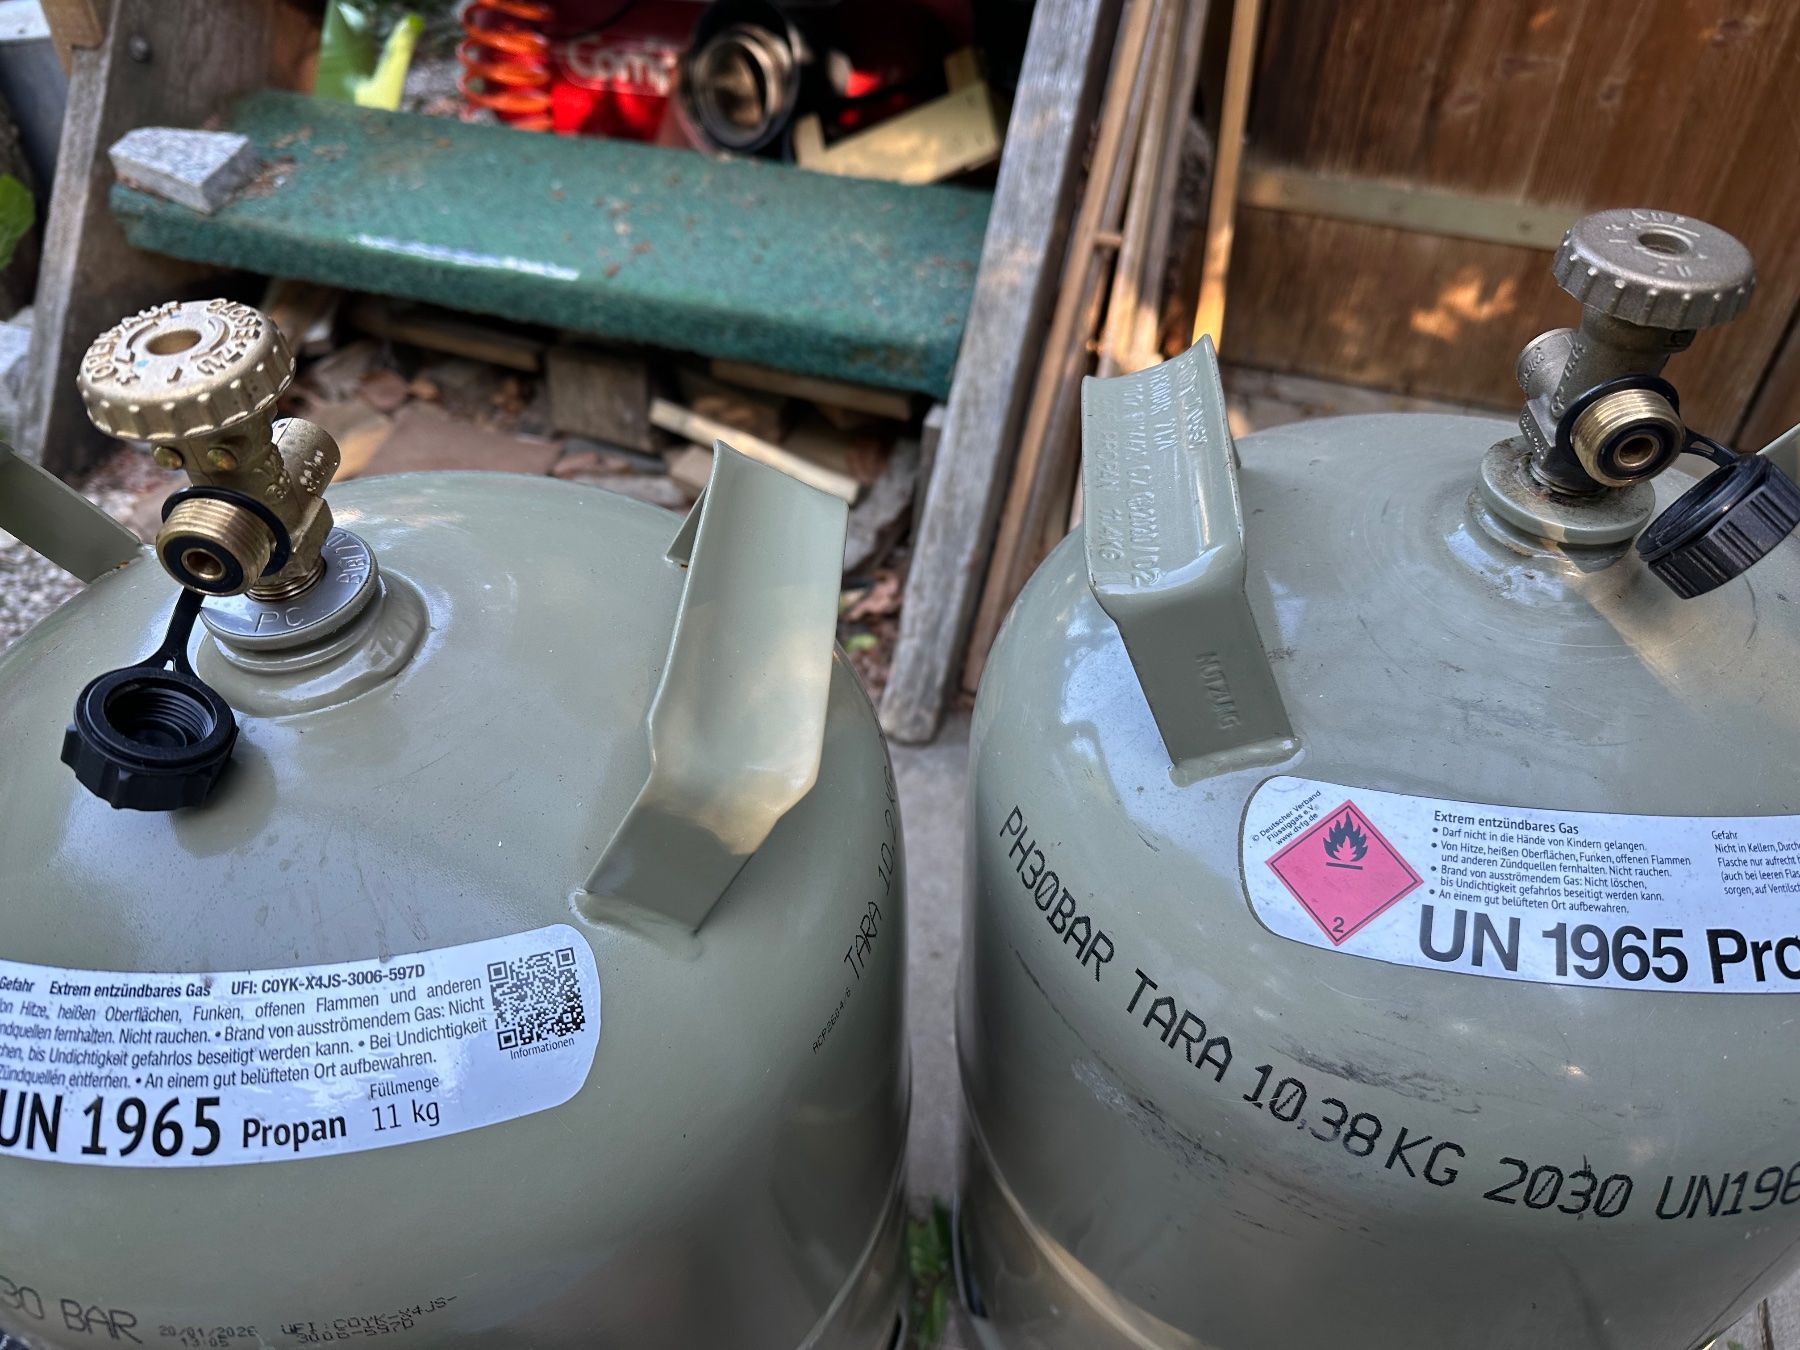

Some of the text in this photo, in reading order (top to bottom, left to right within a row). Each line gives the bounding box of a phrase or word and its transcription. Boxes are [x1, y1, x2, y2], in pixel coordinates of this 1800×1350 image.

[1259, 810, 1293, 837] Deutscher
[1292, 790, 1321, 812] Verband
[1434, 810, 1579, 835] Extrem entzündbares Gas
[1276, 812, 1319, 845] www.dvfg.de
[1442, 827, 1647, 853] Darf nicht in die Hände von Kindern gelangen.
[1711, 830, 1738, 840] Gefahr
[1441, 840, 1692, 866] Von Hitze, heißen Oberflächen, Funken, offenen Flammen
[1714, 843, 1737, 854] Nicht
[1738, 843, 1747, 853] in
[1747, 842, 1778, 854] Kellern,
[1441, 854, 1673, 878] und anderen Zündquellen fernhalten. Nicht rauchen.
[1717, 857, 1748, 867] Flasche
[1750, 858, 1763, 866] nur
[1765, 856, 1796, 866] aufrecht
[1440, 876, 1665, 902] bis Undichtigkeit gefahrlos beseitigt werden kann.
[1441, 865, 1648, 890] Brand von ausströmendem Gas: Nicht löschen,
[1721, 870, 1743, 883] (auch
[1744, 871, 1758, 881] bei
[1759, 870, 1784, 880] leeren
[1439, 889, 1630, 915] An einem gut belüfteten Ort aufbewahren.
[1723, 886, 1754, 897] sorgen,
[1755, 883, 1767, 894] auf
[1332, 916, 1345, 933] 2
[844, 901, 883, 980] TARA
[1419, 904, 1800, 984] UN 1965 Pro
[0, 976, 36, 993] Gefahr
[50, 980, 91, 997] Extrem
[94, 983, 182, 998] entzündbares
[186, 983, 212, 997] Gas
[231, 981, 258, 996] UFI:
[20, 1000, 49, 1020] Hitze,
[57, 1003, 96, 1021] heißen
[105, 1005, 183, 1024] Oberflächen,
[193, 1005, 245, 1022] Funken,
[255, 1002, 305, 1018] offenen
[316, 995, 380, 1014] Flammen
[390, 986, 417, 1004] und
[426, 977, 482, 999] anderen
[1000, 805, 1115, 982] PH30BAR
[1126, 968, 1233, 1083] TARA
[1483, 1155, 1634, 1217] 2030
[53, 1027, 115, 1044] fernhalten.
[119, 1027, 151, 1045] Nicht
[154, 1027, 212, 1045] rauchen.
[224, 1023, 265, 1043] Brand
[268, 1025, 294, 1039] von
[297, 1010, 411, 1036] ausströmendem
[414, 1006, 446, 1023] Gas:
[449, 996, 486, 1016] Nicht
[28, 1045, 46, 1062] bis
[49, 1048, 128, 1069] Undichtigkeit
[131, 1051, 193, 1070] gefahrlos
[197, 1047, 255, 1067] beseitigt
[259, 1044, 311, 1062] werden
[315, 1040, 354, 1057] kann.
[370, 1033, 392, 1051] Bei
[396, 1017, 489, 1047] Undichtigkeit
[510, 1037, 575, 1060] Informationen
[69, 1071, 131, 1089] entfernen.
[144, 1073, 164, 1089] An
[167, 1072, 210, 1089] einem
[213, 1071, 237, 1090] gut
[241, 1066, 310, 1086] belüfteten
[314, 1061, 336, 1079] Ort
[340, 1051, 437, 1076] aufbewahren.
[370, 1076, 440, 1099] Füllmenge
[0, 1089, 440, 1157] UN 1965 Propan 11 kg
[60, 1298, 143, 1344] BAR
